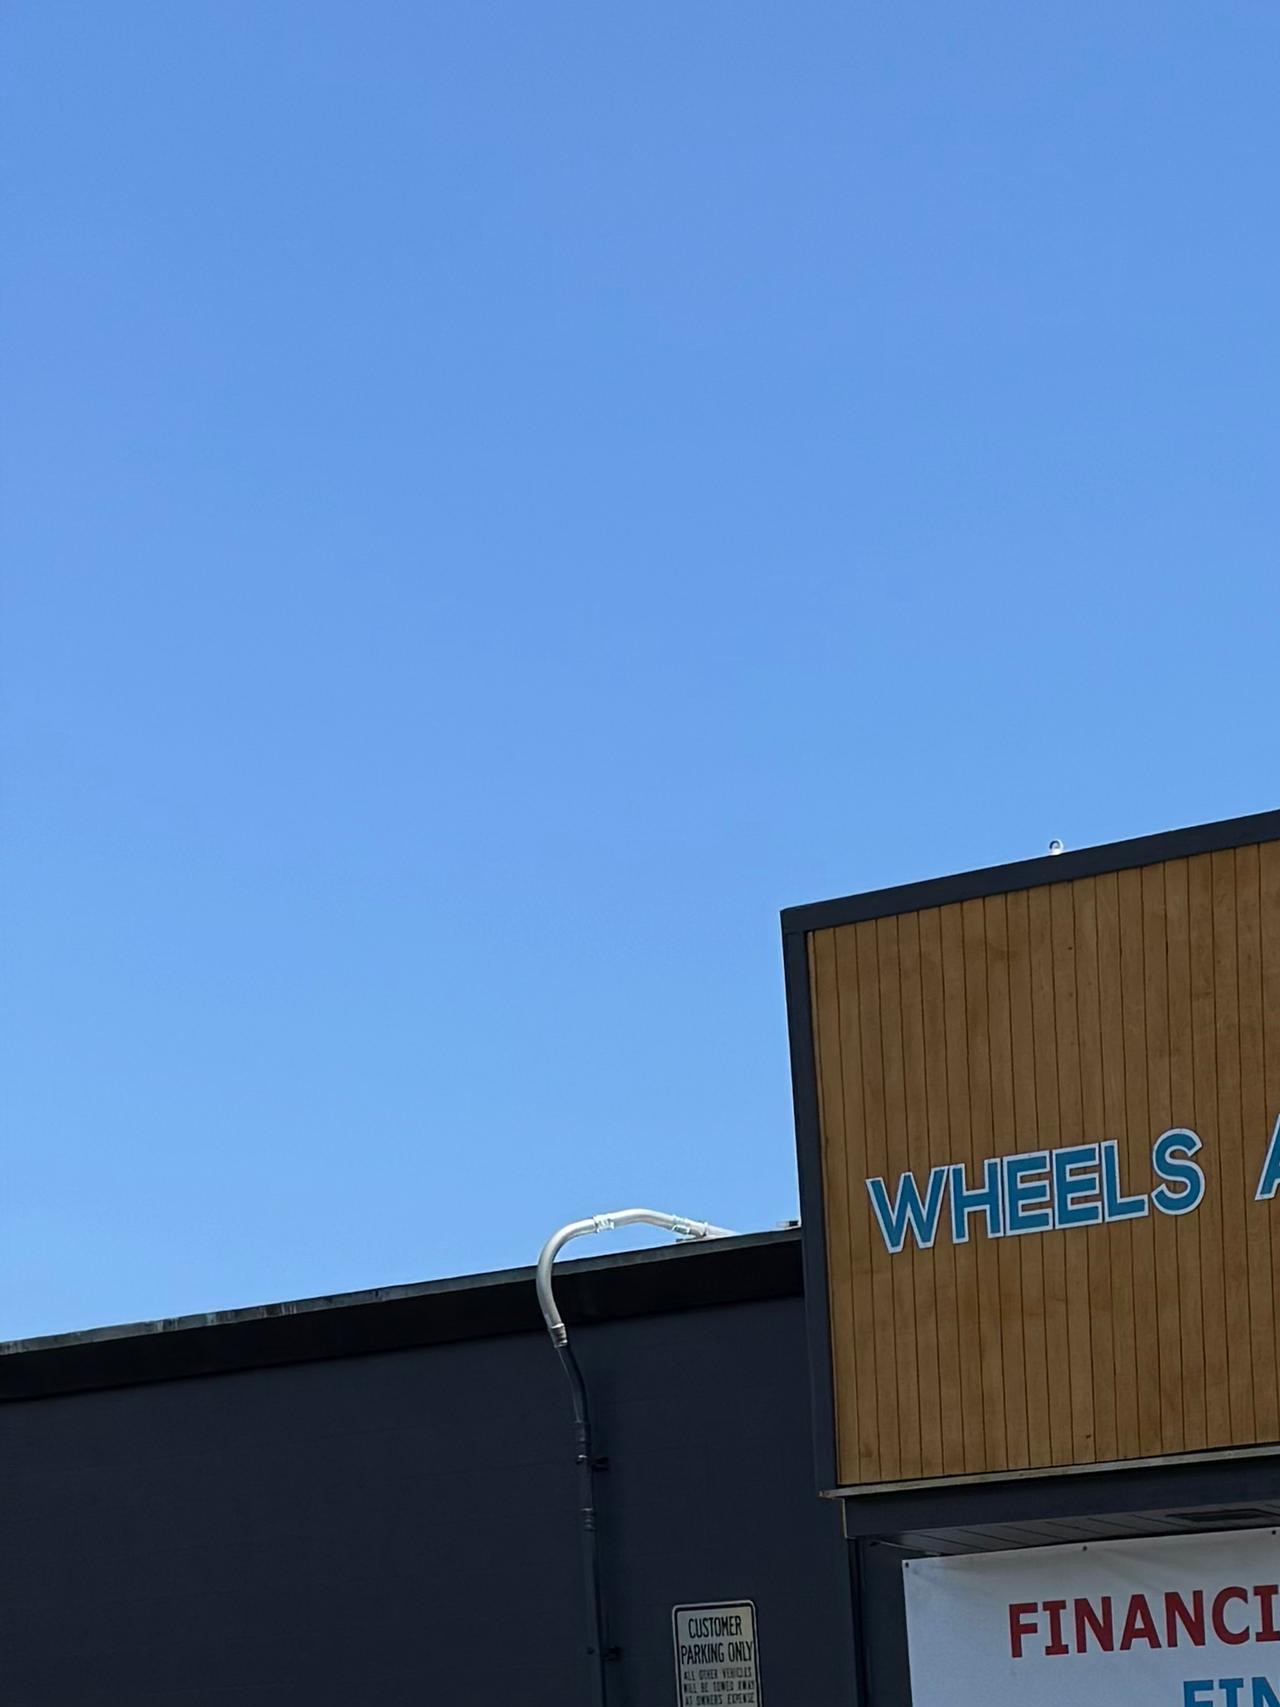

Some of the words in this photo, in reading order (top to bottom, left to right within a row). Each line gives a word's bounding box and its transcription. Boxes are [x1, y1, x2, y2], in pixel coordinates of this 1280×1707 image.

[866, 1127, 1205, 1254] WHEELS
[688, 1615, 742, 1639] CUSTOMER
[681, 1643, 724, 1665] PARKING
[728, 1641, 753, 1662] ONLY
[684, 1670, 696, 1681] ALL
[699, 1668, 718, 1680] OTHER
[722, 1666, 751, 1679] VEHICLES
[684, 1683, 697, 1694] WILL
[701, 1682, 709, 1693] BE
[713, 1681, 734, 1692] TOWED
[738, 1680, 754, 1691] AWAY
[685, 1695, 693, 1706] AT
[727, 1692, 754, 1705] EXPENSE
